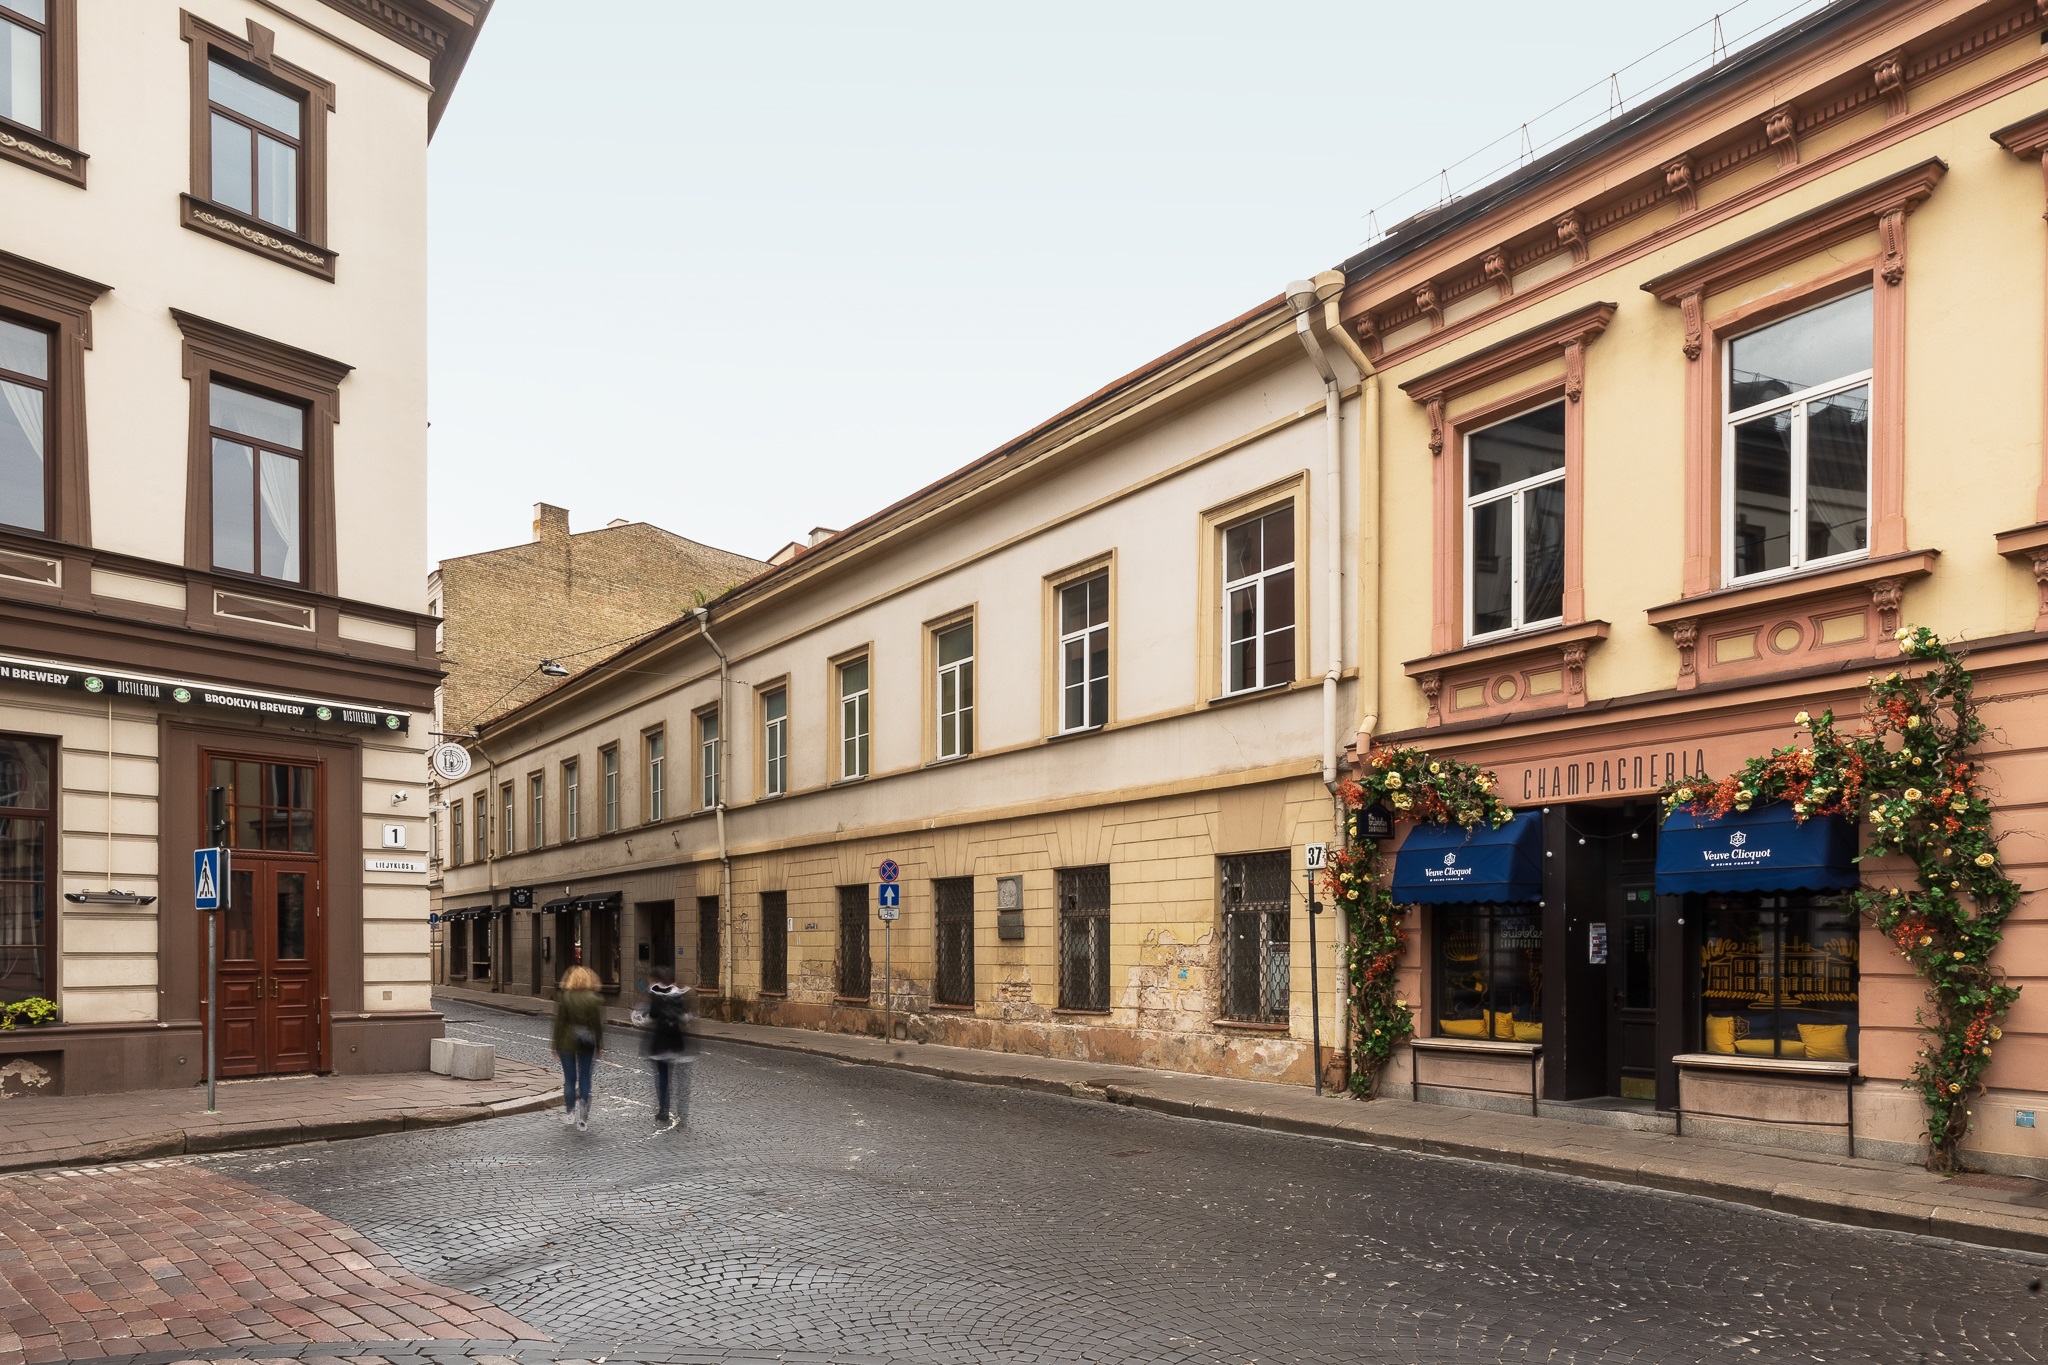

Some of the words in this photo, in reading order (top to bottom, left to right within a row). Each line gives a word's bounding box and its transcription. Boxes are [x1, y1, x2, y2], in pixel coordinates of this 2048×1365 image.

[12, 668, 69, 685] BREWERY
[117, 680, 160, 698] DISTILERIJA
[205, 693, 259, 710] BROOKLYN
[260, 701, 305, 716] BREWERY
[342, 709, 377, 725] DISTILERIJA
[1523, 748, 1705, 800] CHAMPAGNERIA
[392, 828, 398, 844] 1
[1308, 846, 1322, 866] 37
[1703, 850, 1730, 861] Veuve
[1731, 848, 1771, 860] Clicquot
[1425, 868, 1444, 877] Veuve
[1444, 867, 1472, 877] Clicquot
[1500, 925, 1543, 938] bubbles
